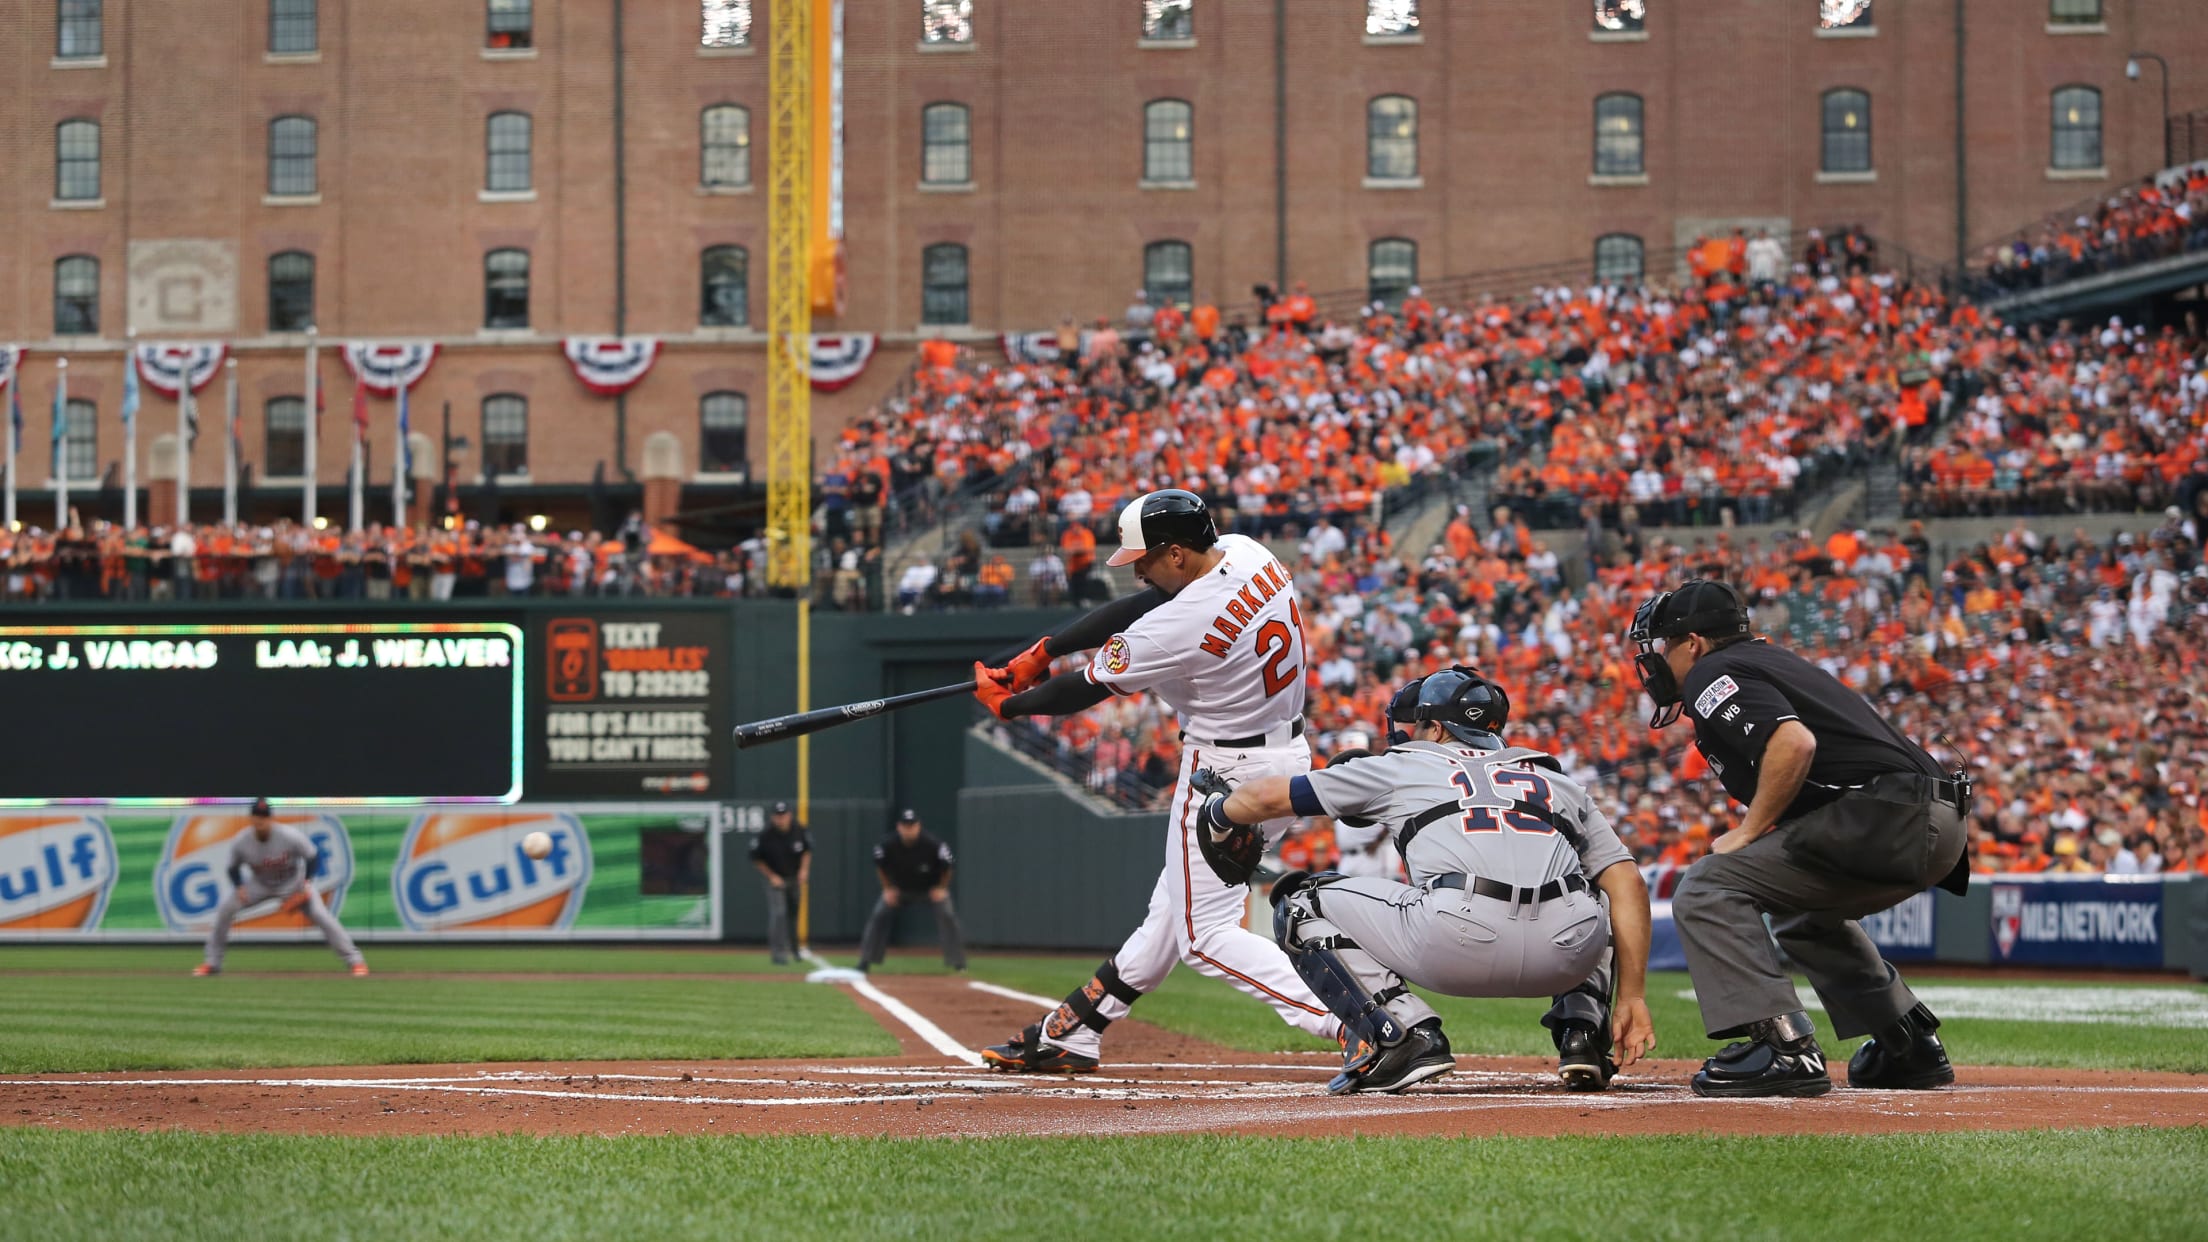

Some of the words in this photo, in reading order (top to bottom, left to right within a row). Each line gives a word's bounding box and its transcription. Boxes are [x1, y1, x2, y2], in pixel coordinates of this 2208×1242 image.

[602, 622, 661, 648] TEXT
[48, 641, 79, 670] J.
[84, 640, 218, 669] VARGAS
[256, 639, 332, 668] LAA:
[336, 639, 369, 668] J.
[373, 638, 510, 667] WEAVER
[602, 671, 634, 696] TO
[547, 712, 589, 735] FOR
[1721, 703, 1741, 722] WB
[547, 737, 589, 760] YOU
[591, 737, 650, 760] CAN'T
[1450, 770, 1556, 835] 13
[720, 806, 764, 832] 318
[0, 834, 97, 901] ulf
[169, 832, 333, 915] Gf
[407, 831, 571, 916] Gulf
[2020, 902, 2059, 942] MLB
[2061, 902, 2158, 943] NETWORK
